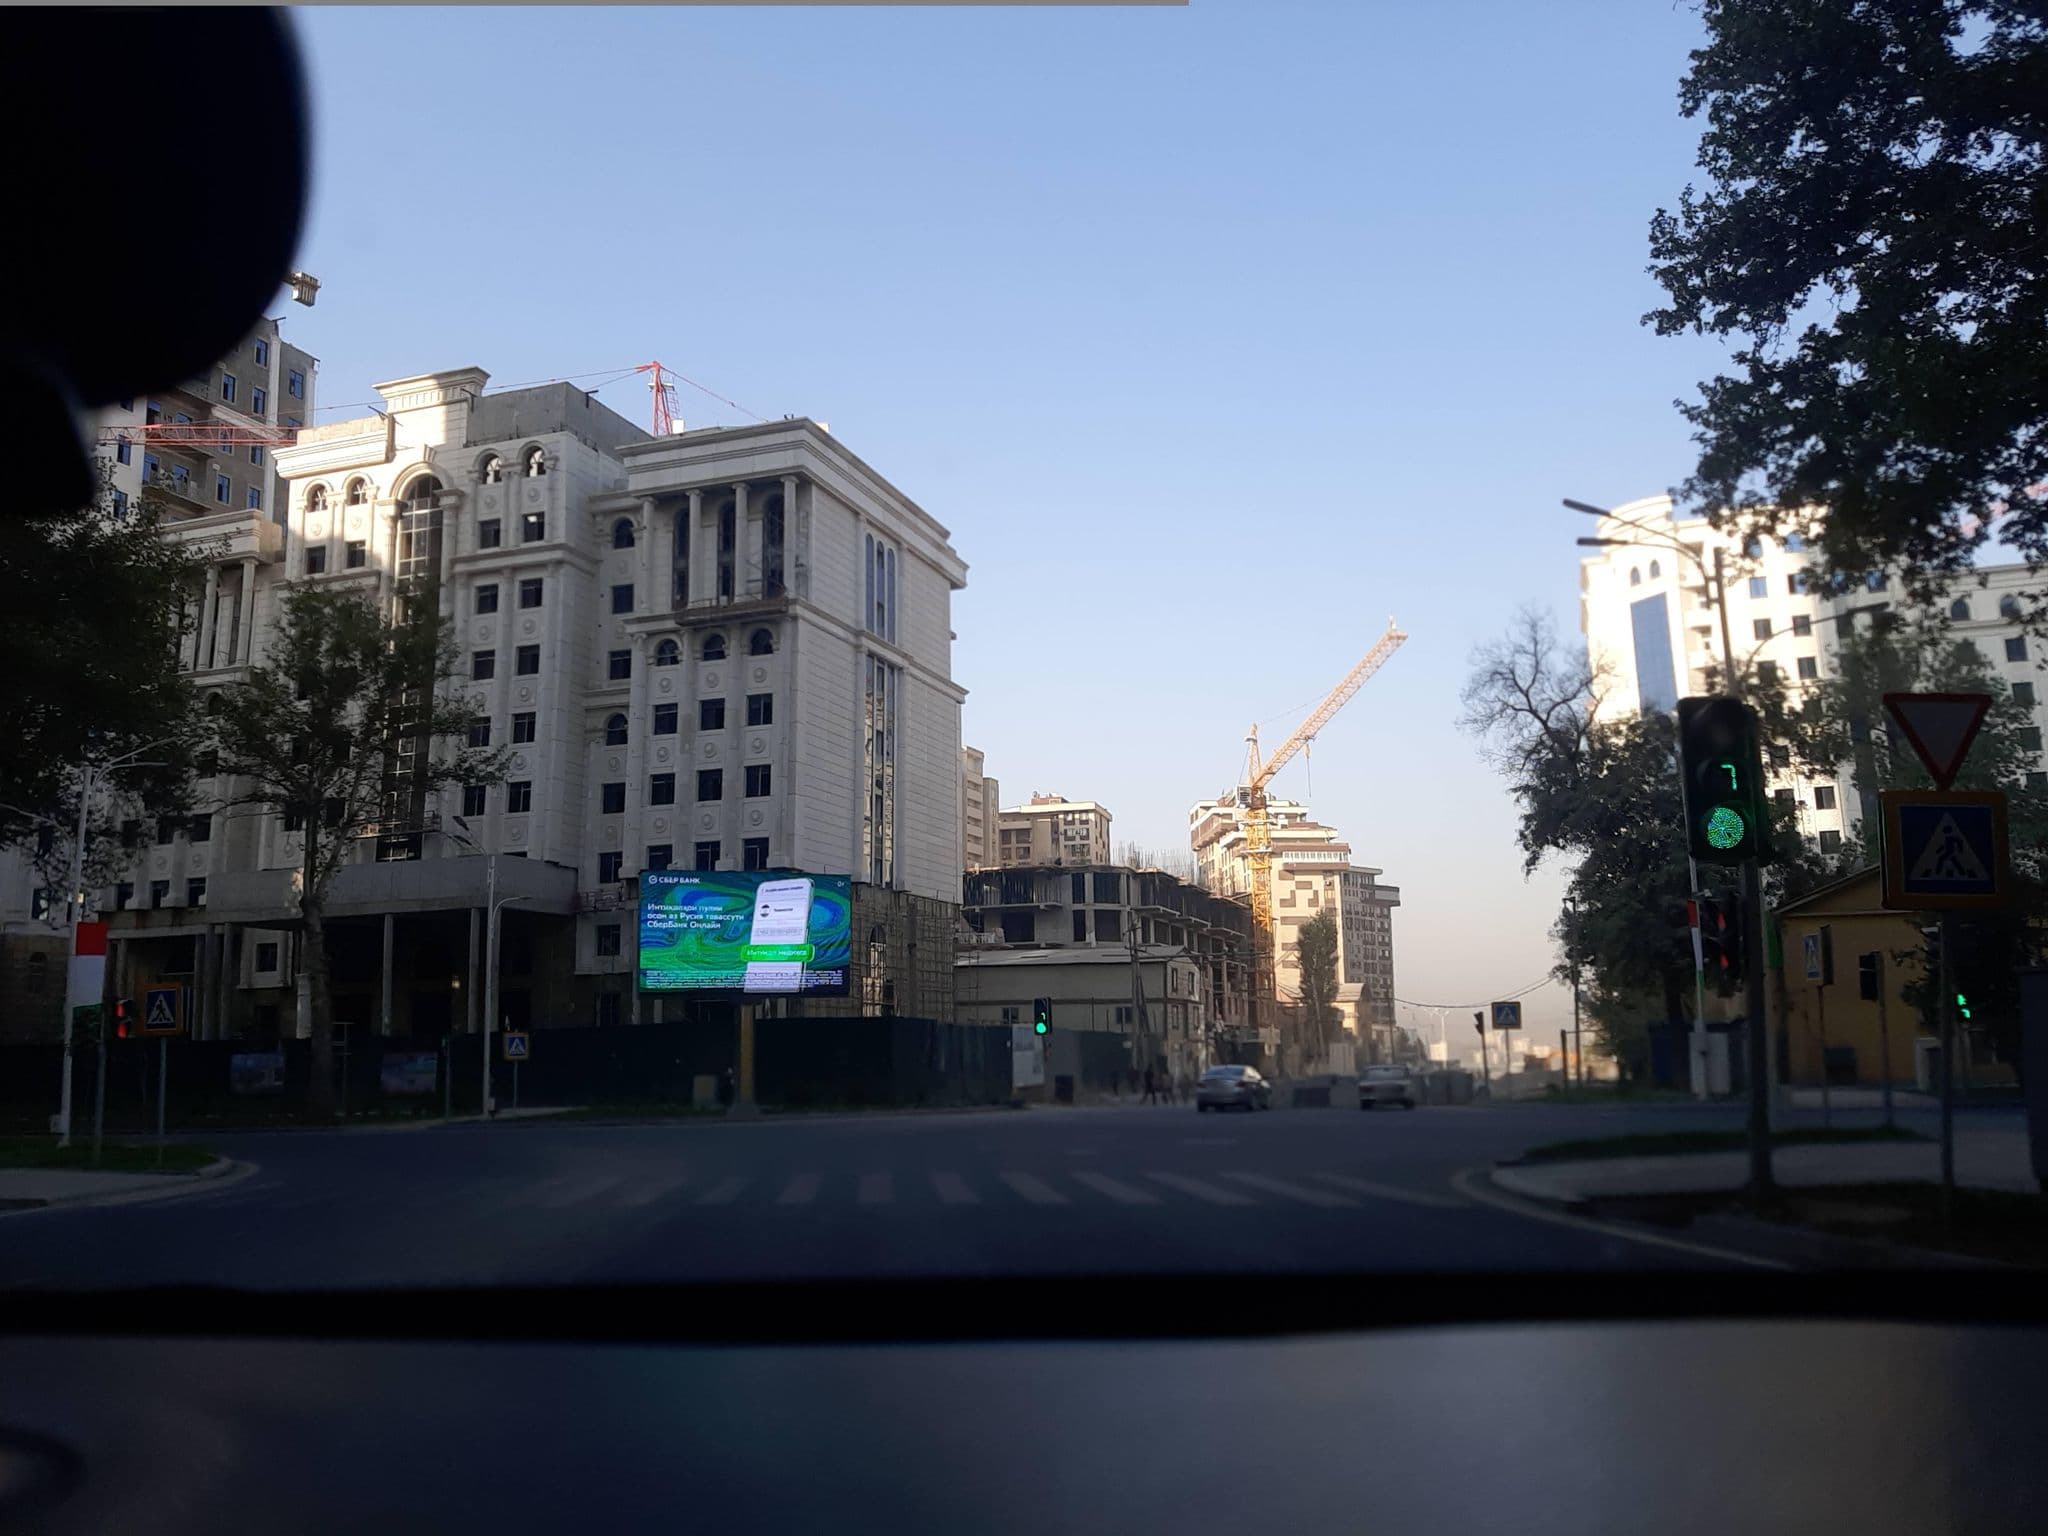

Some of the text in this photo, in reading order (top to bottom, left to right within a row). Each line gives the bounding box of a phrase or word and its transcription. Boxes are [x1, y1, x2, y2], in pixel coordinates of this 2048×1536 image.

[1720, 764, 1737, 791] 7
[658, 876, 701, 885] СБЕР БАНК
[689, 921, 721, 929] Онлайн
